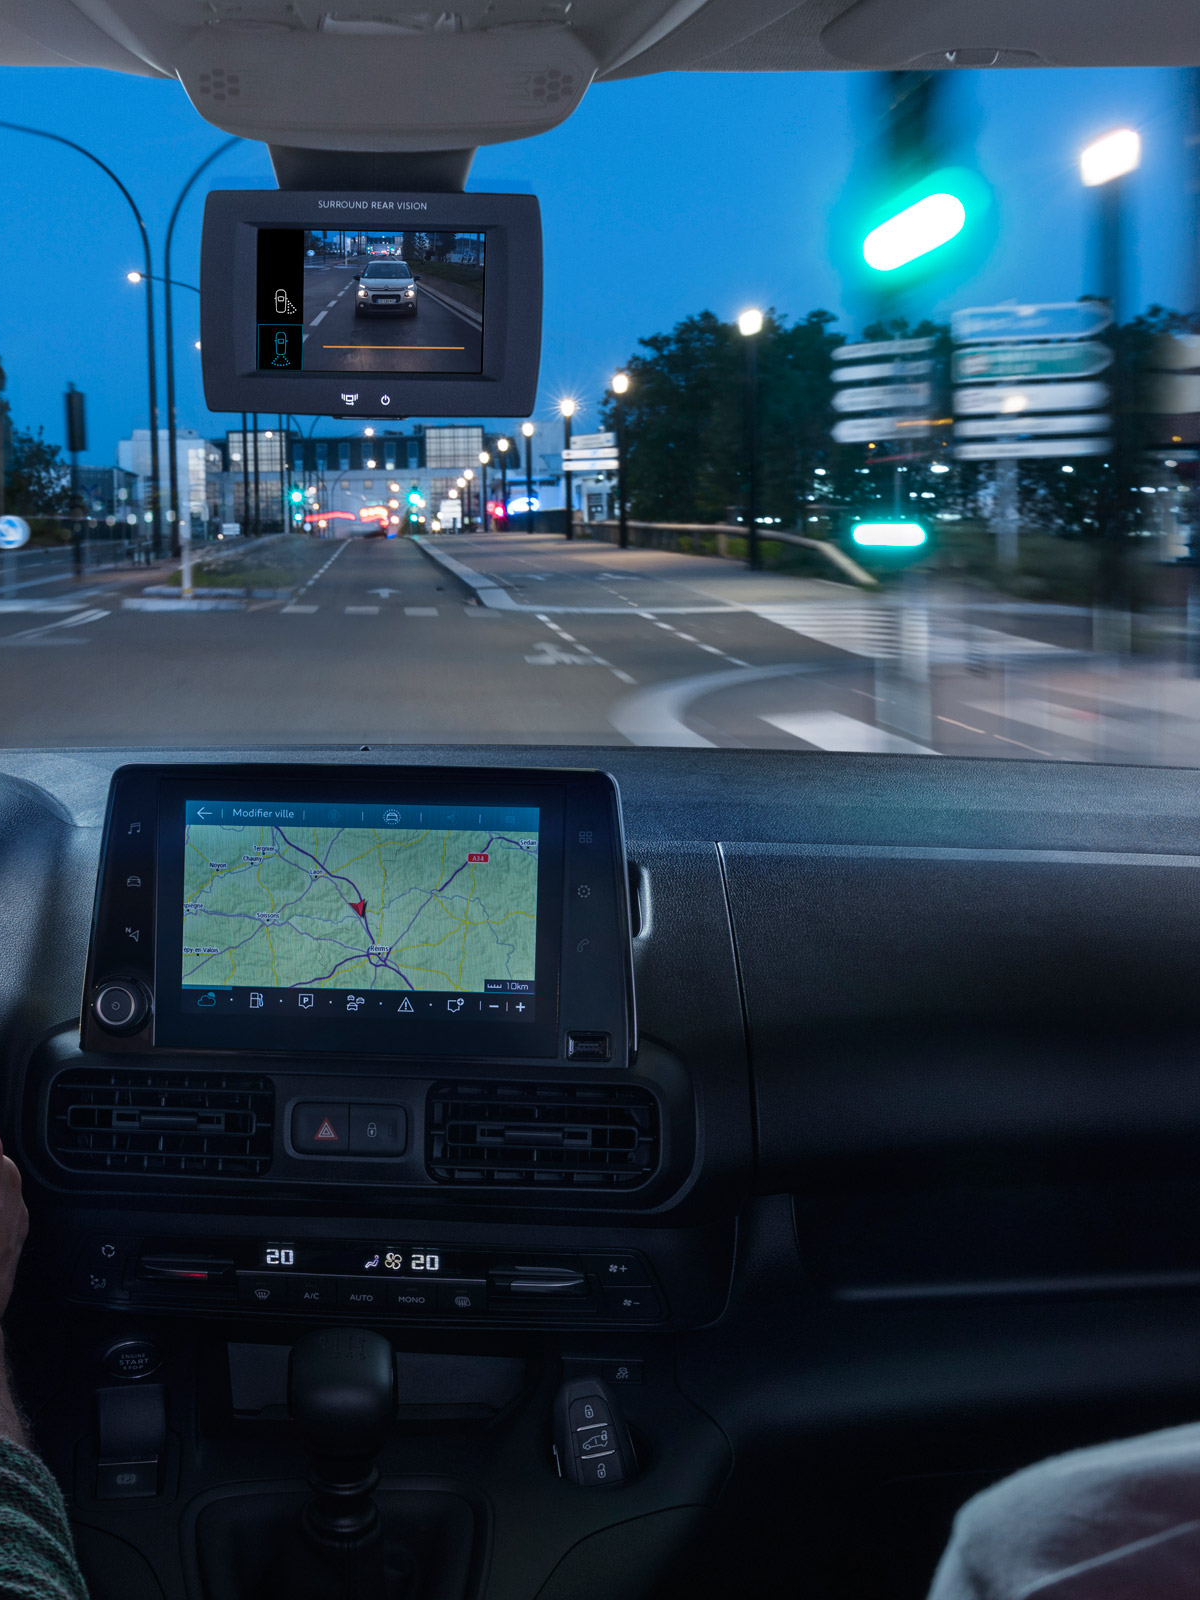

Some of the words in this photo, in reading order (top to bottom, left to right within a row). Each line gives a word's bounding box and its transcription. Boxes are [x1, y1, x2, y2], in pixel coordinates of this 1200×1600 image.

[318, 200, 368, 210] SURROUND
[371, 201, 394, 210] REAR
[397, 202, 428, 211] VISION
[232, 808, 273, 818] Modifier
[275, 809, 295, 819] ville
[210, 862, 226, 870] Noyon
[506, 982, 529, 991] 10km
[265, 1248, 295, 1266] 20
[411, 1254, 440, 1271] 20
[303, 1291, 320, 1300] A/C
[349, 1294, 374, 1302] AUTO
[398, 1295, 426, 1304] MONO
[120, 1352, 146, 1360] ENGINE
[119, 1357, 150, 1366] START
